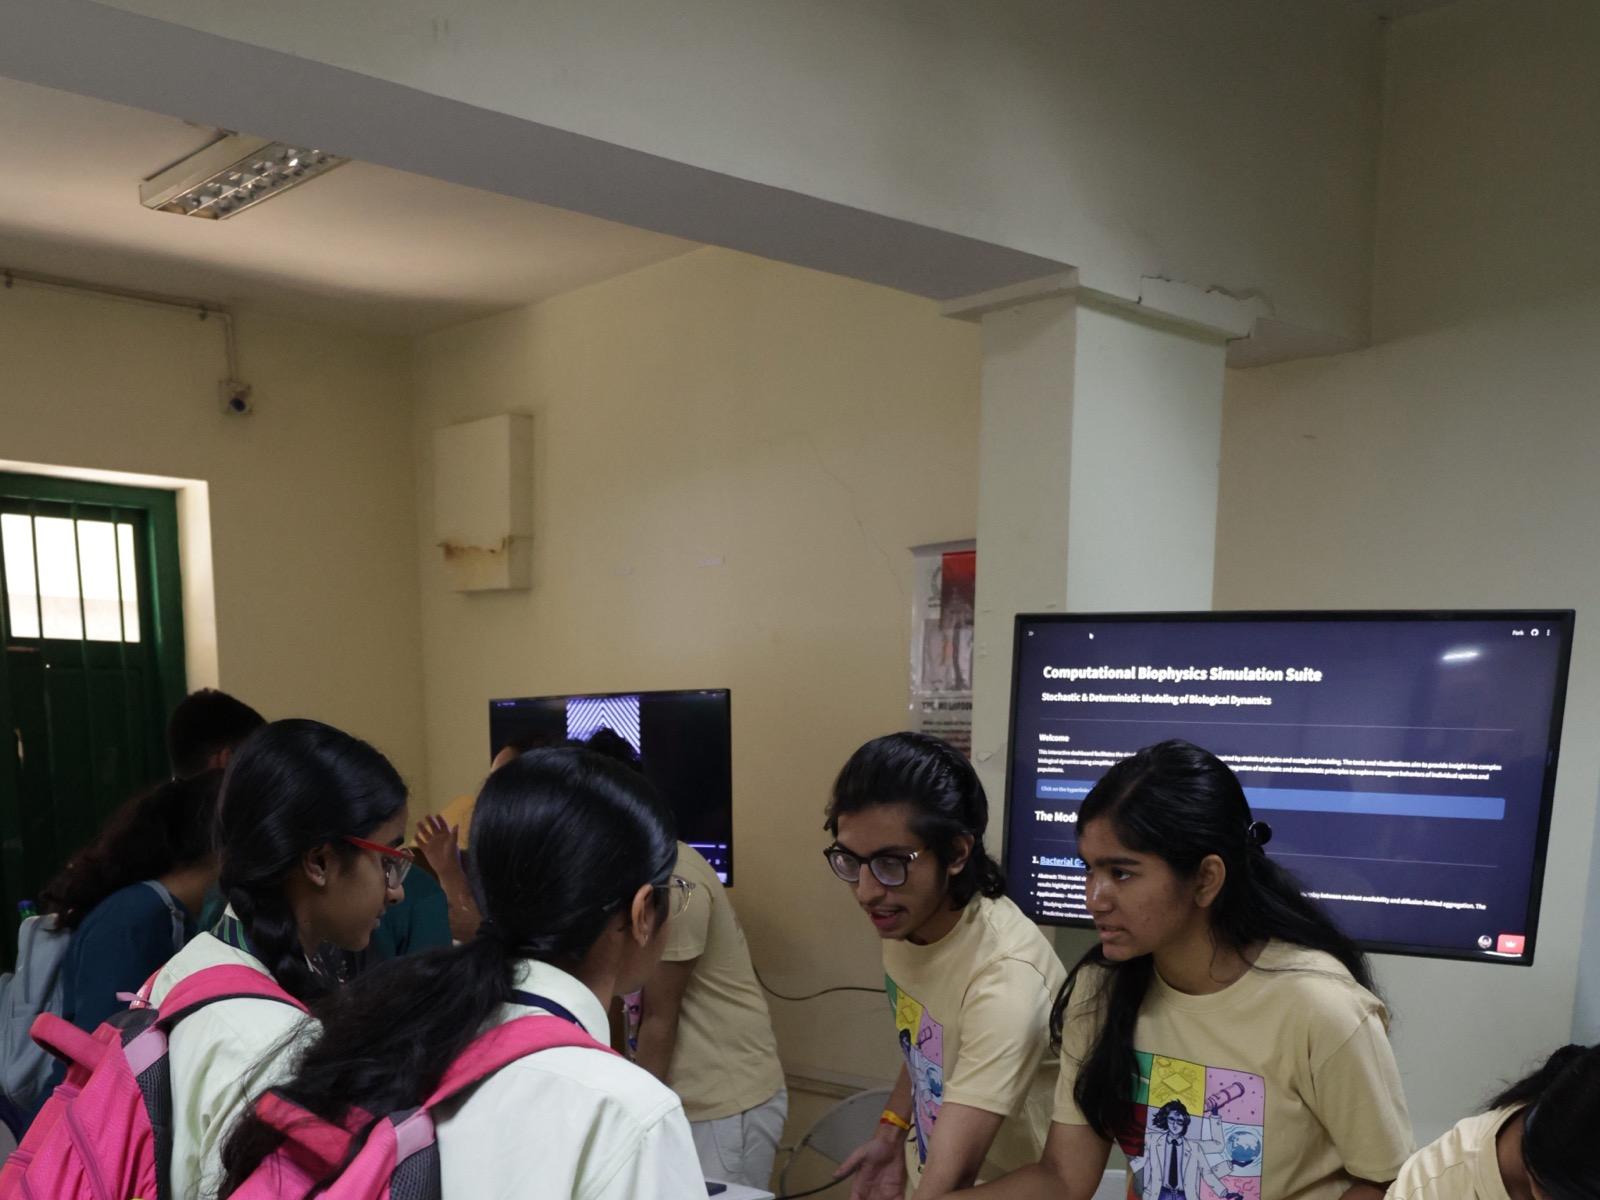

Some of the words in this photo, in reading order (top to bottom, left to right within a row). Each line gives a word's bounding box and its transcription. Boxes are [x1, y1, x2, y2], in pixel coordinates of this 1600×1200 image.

[1043, 665, 1136, 681] Computational
[1138, 666, 1207, 683] Biophysics
[1209, 667, 1283, 682] Simulation
[1285, 668, 1322, 682] Suite
[1041, 692, 1080, 702] Stochastic
[1081, 693, 1088, 702] &
[1089, 693, 1141, 703] Deterministic
[1142, 694, 1178, 706] Modeling
[1179, 694, 1189, 704] of
[1189, 695, 1229, 707] Biological
[1230, 697, 1272, 706] Dynamics
[1039, 733, 1070, 742] Welcome
[1034, 811, 1054, 821] The
[1032, 856, 1039, 864] 1.
[1040, 856, 1074, 866] Bacterial
